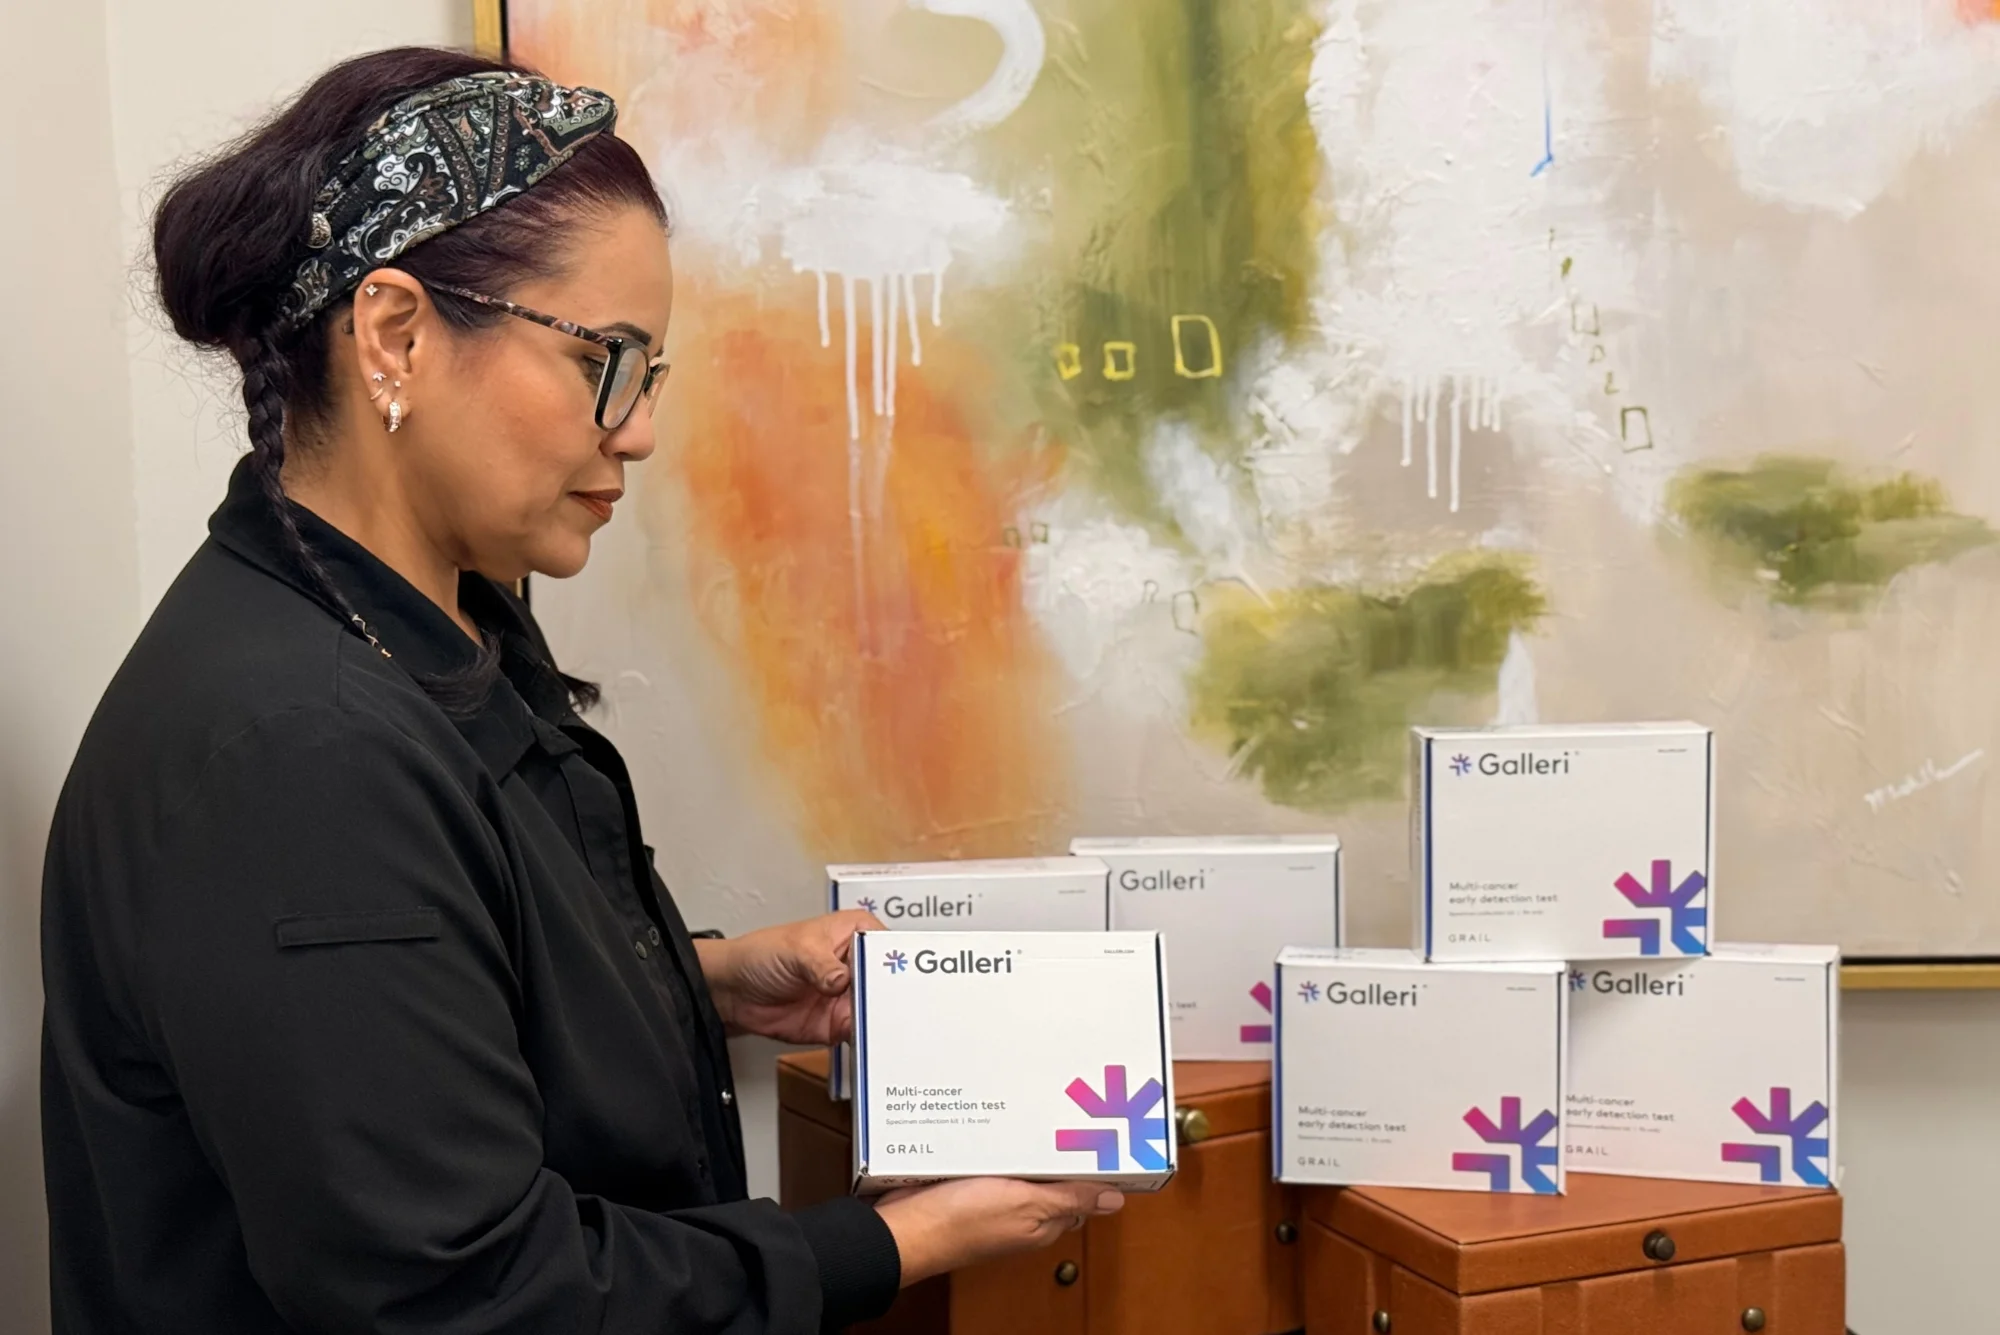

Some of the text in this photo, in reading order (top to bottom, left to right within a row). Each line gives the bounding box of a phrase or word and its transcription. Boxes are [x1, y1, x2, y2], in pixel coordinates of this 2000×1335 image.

[1477, 752, 1569, 776] Galleri
[1119, 868, 1205, 891] Galleri
[1448, 882, 1519, 892] Multi-cancer
[884, 894, 972, 919] Galleri
[1448, 894, 1558, 906] early detection test
[1448, 933, 1492, 943] GRAIL
[914, 949, 1012, 975] Galleri
[1592, 970, 1683, 996] Galleri
[1326, 981, 1417, 1007] Galleri
[886, 1086, 963, 1097] Multi-cancer
[886, 1100, 1007, 1113] early detection test
[1298, 1106, 1367, 1117] Multi-cancer
[1596, 1109, 1649, 1120] detection
[1652, 1113, 1675, 1122] test
[1298, 1120, 1407, 1133] early detection test
[886, 1144, 935, 1155] GRAIL
[1297, 1156, 1341, 1168] GRAIL
